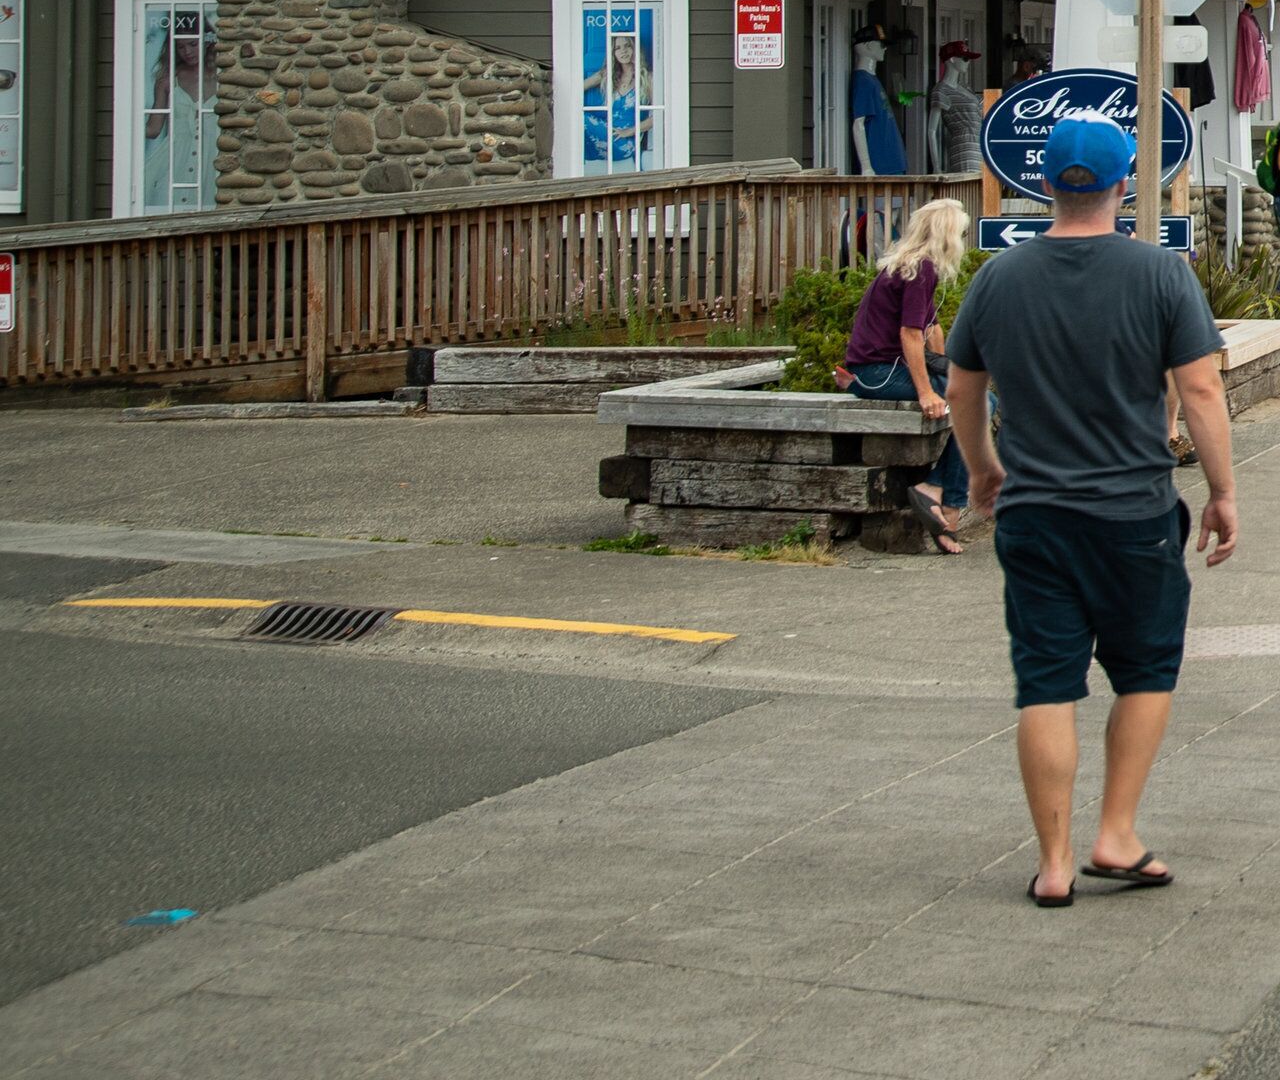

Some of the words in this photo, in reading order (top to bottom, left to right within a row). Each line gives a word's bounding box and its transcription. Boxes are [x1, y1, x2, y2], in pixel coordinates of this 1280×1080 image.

[150, 16, 197, 29] ROXY
[586, 15, 632, 27] ROXY
[750, 13, 769, 23] Parking
[753, 23, 766, 31] Only
[1014, 125, 1054, 134] VACAT
